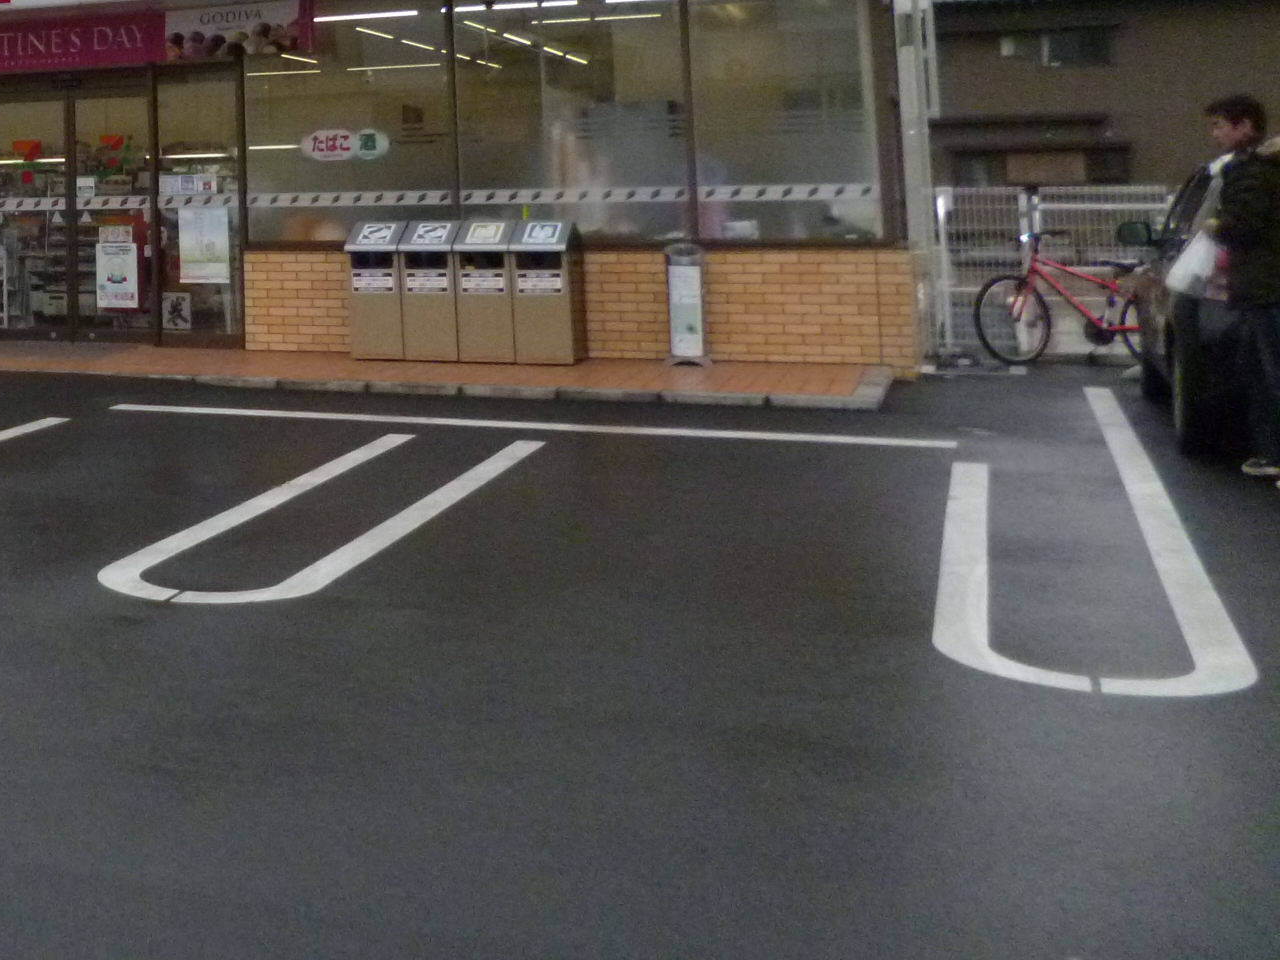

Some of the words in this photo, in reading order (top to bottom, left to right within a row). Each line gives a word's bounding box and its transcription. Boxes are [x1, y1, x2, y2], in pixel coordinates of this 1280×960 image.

[199, 9, 262, 26] GODIVA
[92, 24, 147, 51] DAY
[311, 133, 352, 153] たばこ
